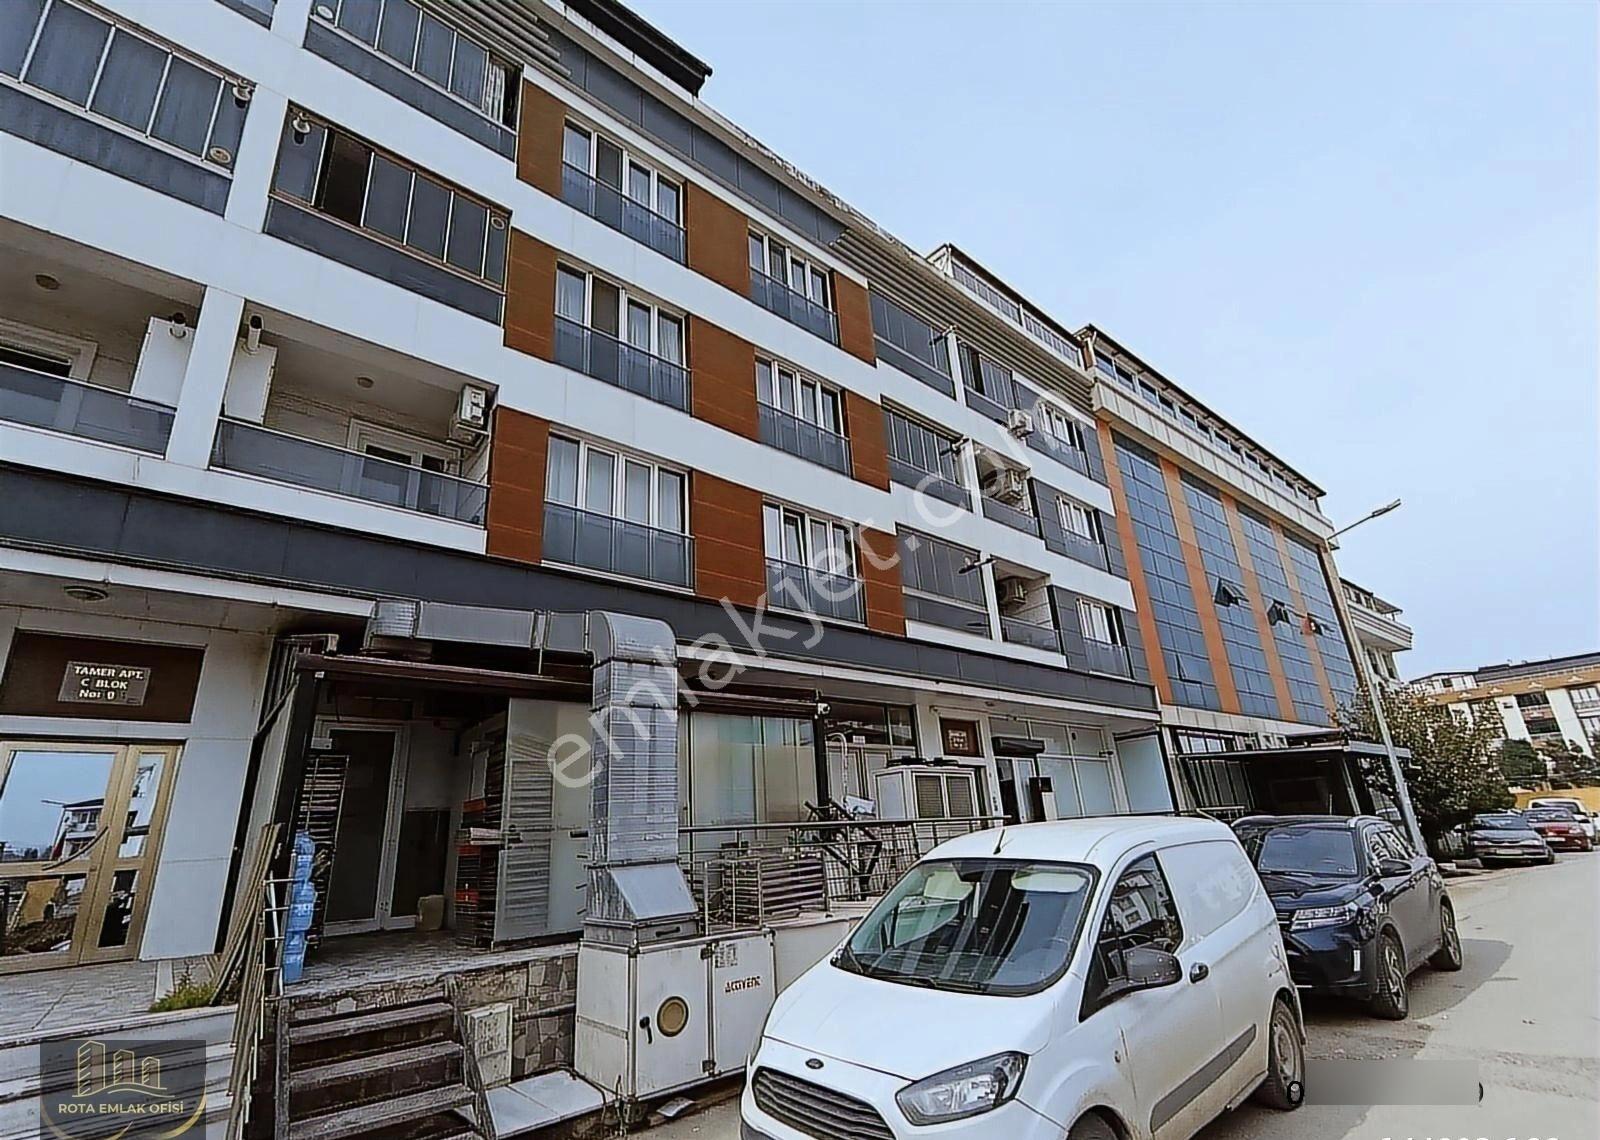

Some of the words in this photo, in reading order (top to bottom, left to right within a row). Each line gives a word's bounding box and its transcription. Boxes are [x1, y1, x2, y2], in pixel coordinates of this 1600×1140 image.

[74, 666, 116, 677] TAMER
[80, 678, 90, 687] C
[95, 679, 128, 690] BLOK
